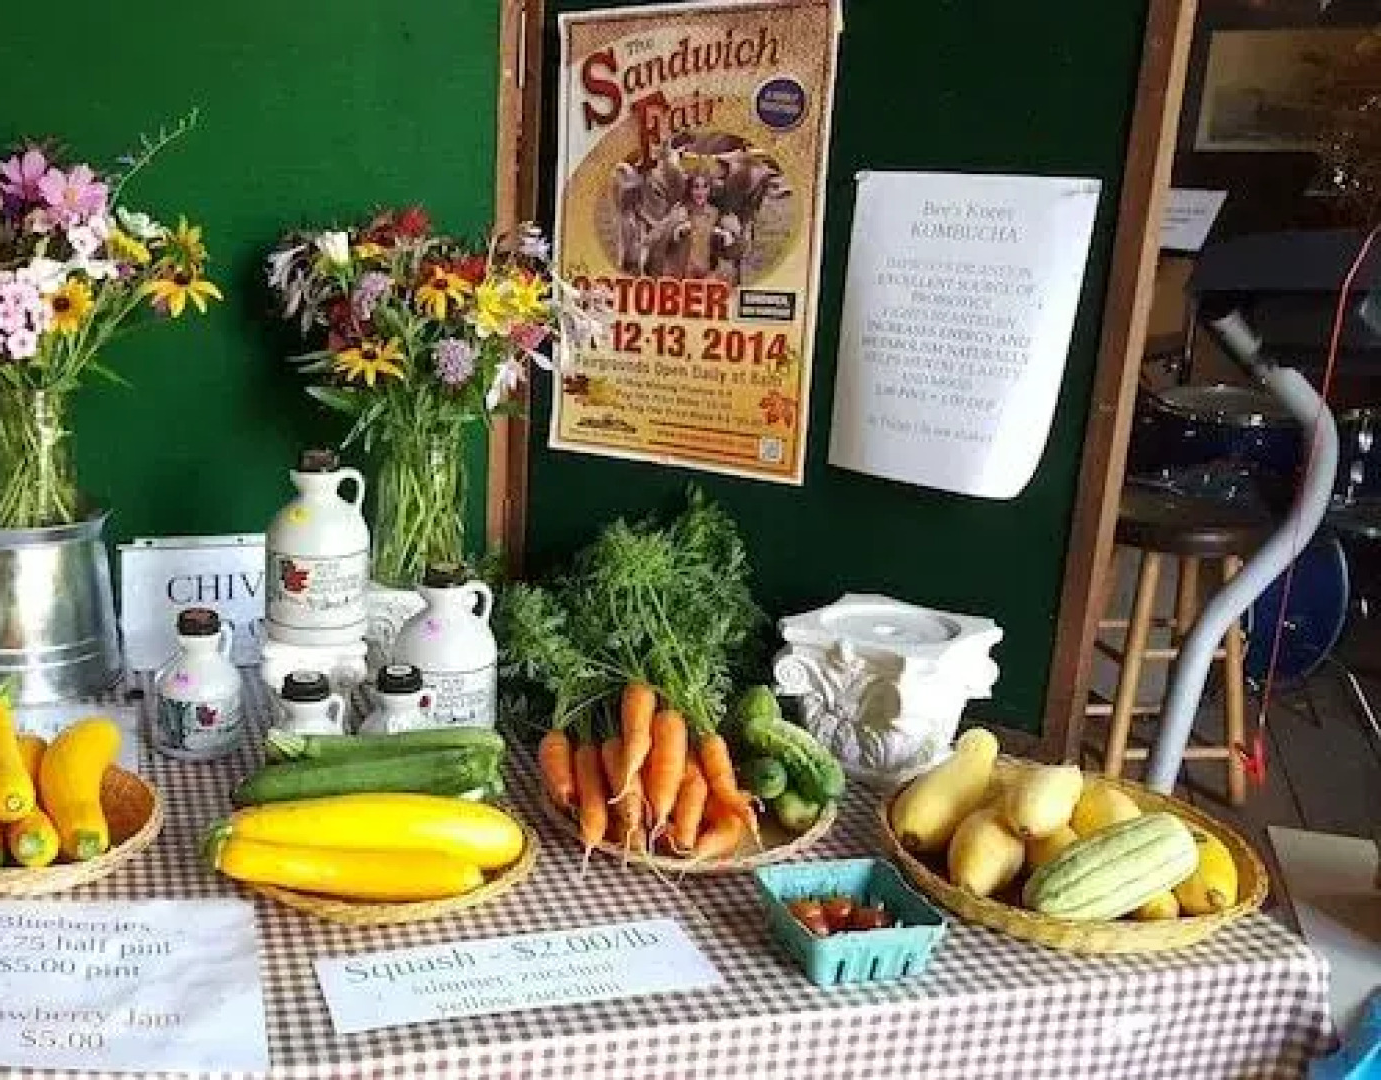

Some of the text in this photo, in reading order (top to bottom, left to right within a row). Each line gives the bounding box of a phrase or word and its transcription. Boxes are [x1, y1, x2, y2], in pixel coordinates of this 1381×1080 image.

[626, 38, 653, 56] The
[582, 27, 780, 131] Sandwich
[630, 86, 722, 168] Fair
[910, 221, 1020, 243] KOMBUCHA
[572, 276, 730, 321] OCTOBER
[939, 326, 995, 344] ENERGY
[701, 328, 788, 368] 2014
[654, 361, 687, 379] Open
[57, 934, 107, 953] half
[119, 941, 174, 959] pint
[344, 948, 477, 983] Squash
[511, 925, 661, 962] $2.00/lb
[84, 964, 141, 982] pint
[521, 961, 616, 983] zucchini
[436, 979, 624, 1014] yellow zucchini
[124, 1007, 188, 1027] Jam
[19, 1029, 105, 1049] $5.00
